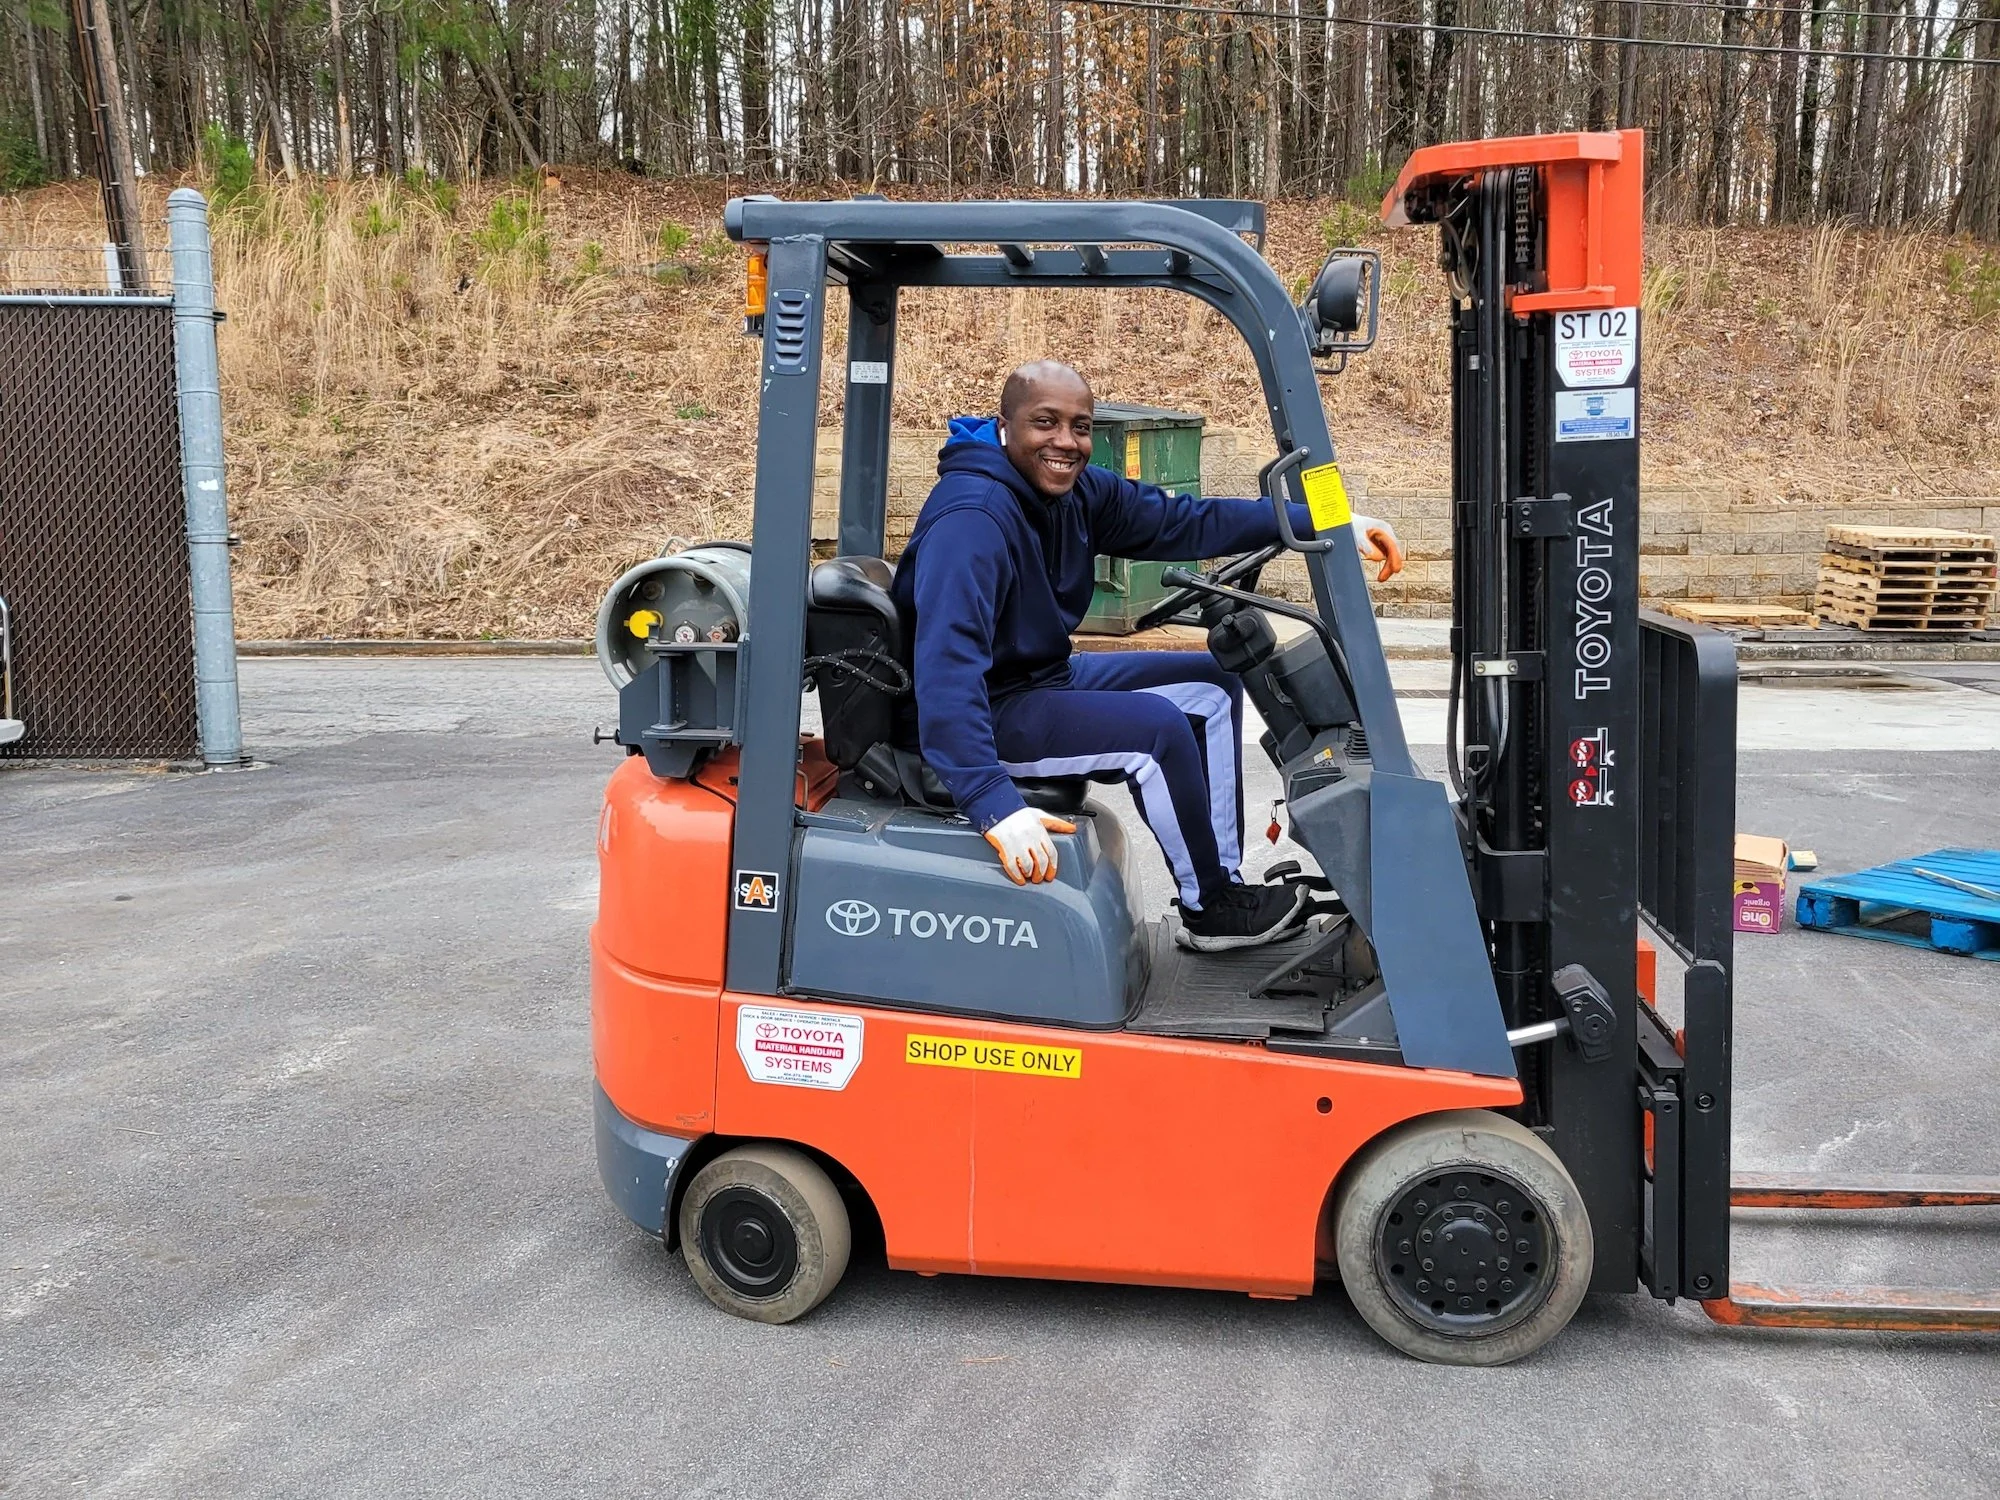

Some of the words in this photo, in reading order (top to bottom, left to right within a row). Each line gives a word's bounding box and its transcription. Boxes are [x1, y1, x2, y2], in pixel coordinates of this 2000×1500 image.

[1561, 313, 1591, 339] ST
[1599, 311, 1627, 337] 02
[1584, 349, 1623, 358] TOYOTA
[1575, 368, 1616, 377] SYSTEMS
[1306, 467, 1337, 480] Attention
[1574, 497, 1614, 700] TOYOTA
[1743, 898, 1771, 906] organic
[1742, 911, 1771, 926] One
[887, 908, 1039, 949] TOYOTA
[781, 1027, 844, 1044] TOYOTA
[757, 1041, 798, 1054] MATERIAL
[799, 1045, 842, 1057] HANDLING
[908, 1040, 966, 1064] SHOP
[974, 1046, 1015, 1068] USE
[1021, 1051, 1076, 1073] ONLY
[765, 1056, 832, 1074] SYSTEMS
